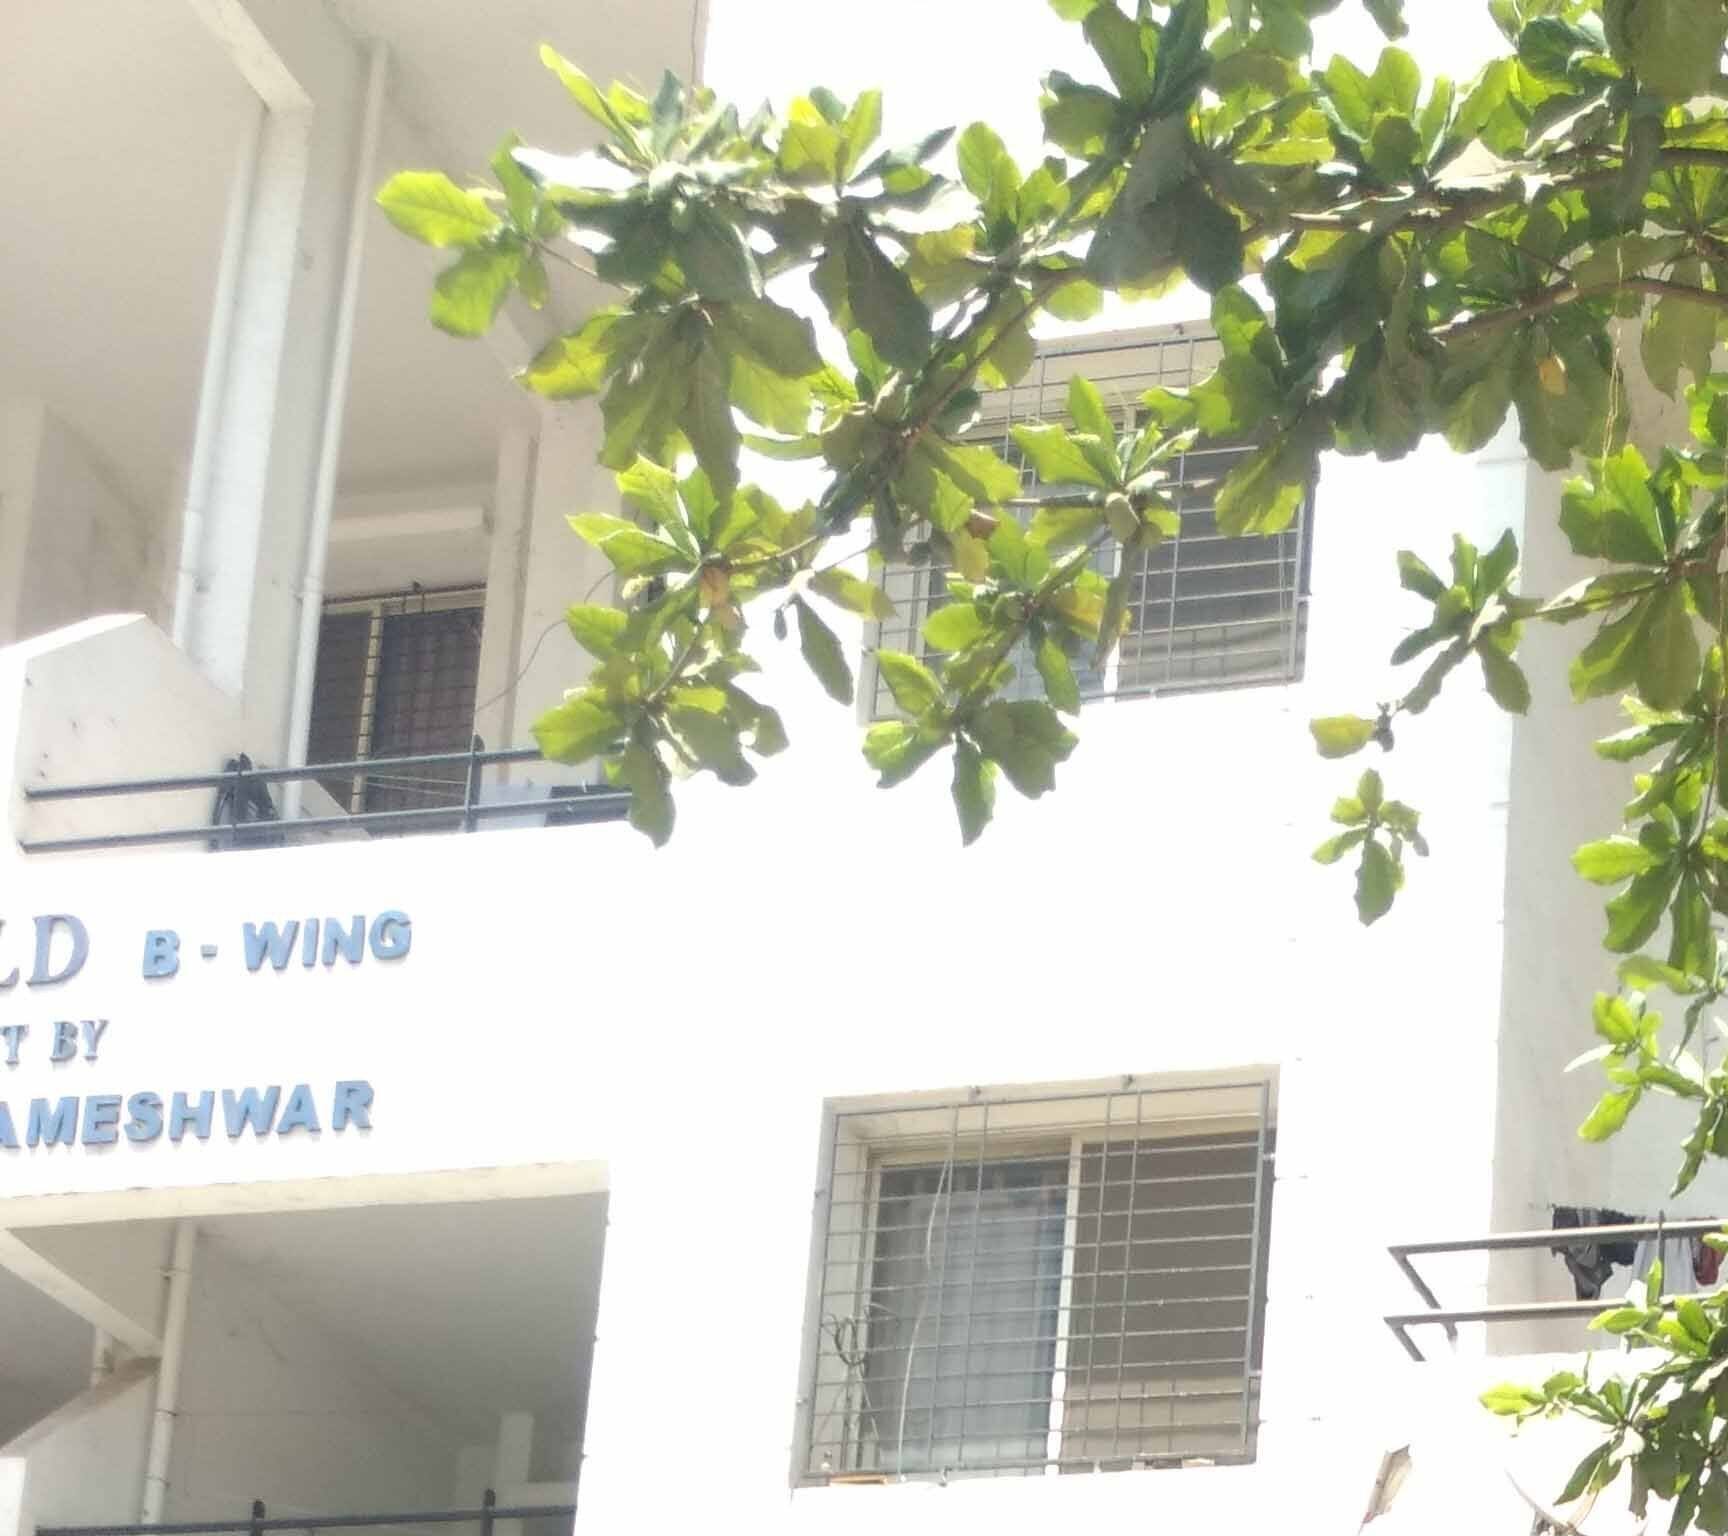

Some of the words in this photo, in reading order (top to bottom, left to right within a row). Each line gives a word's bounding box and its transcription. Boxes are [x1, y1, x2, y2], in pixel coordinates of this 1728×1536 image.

[143, 930, 181, 978] B
[242, 911, 412, 971] WING
[50, 1019, 109, 1062] BY
